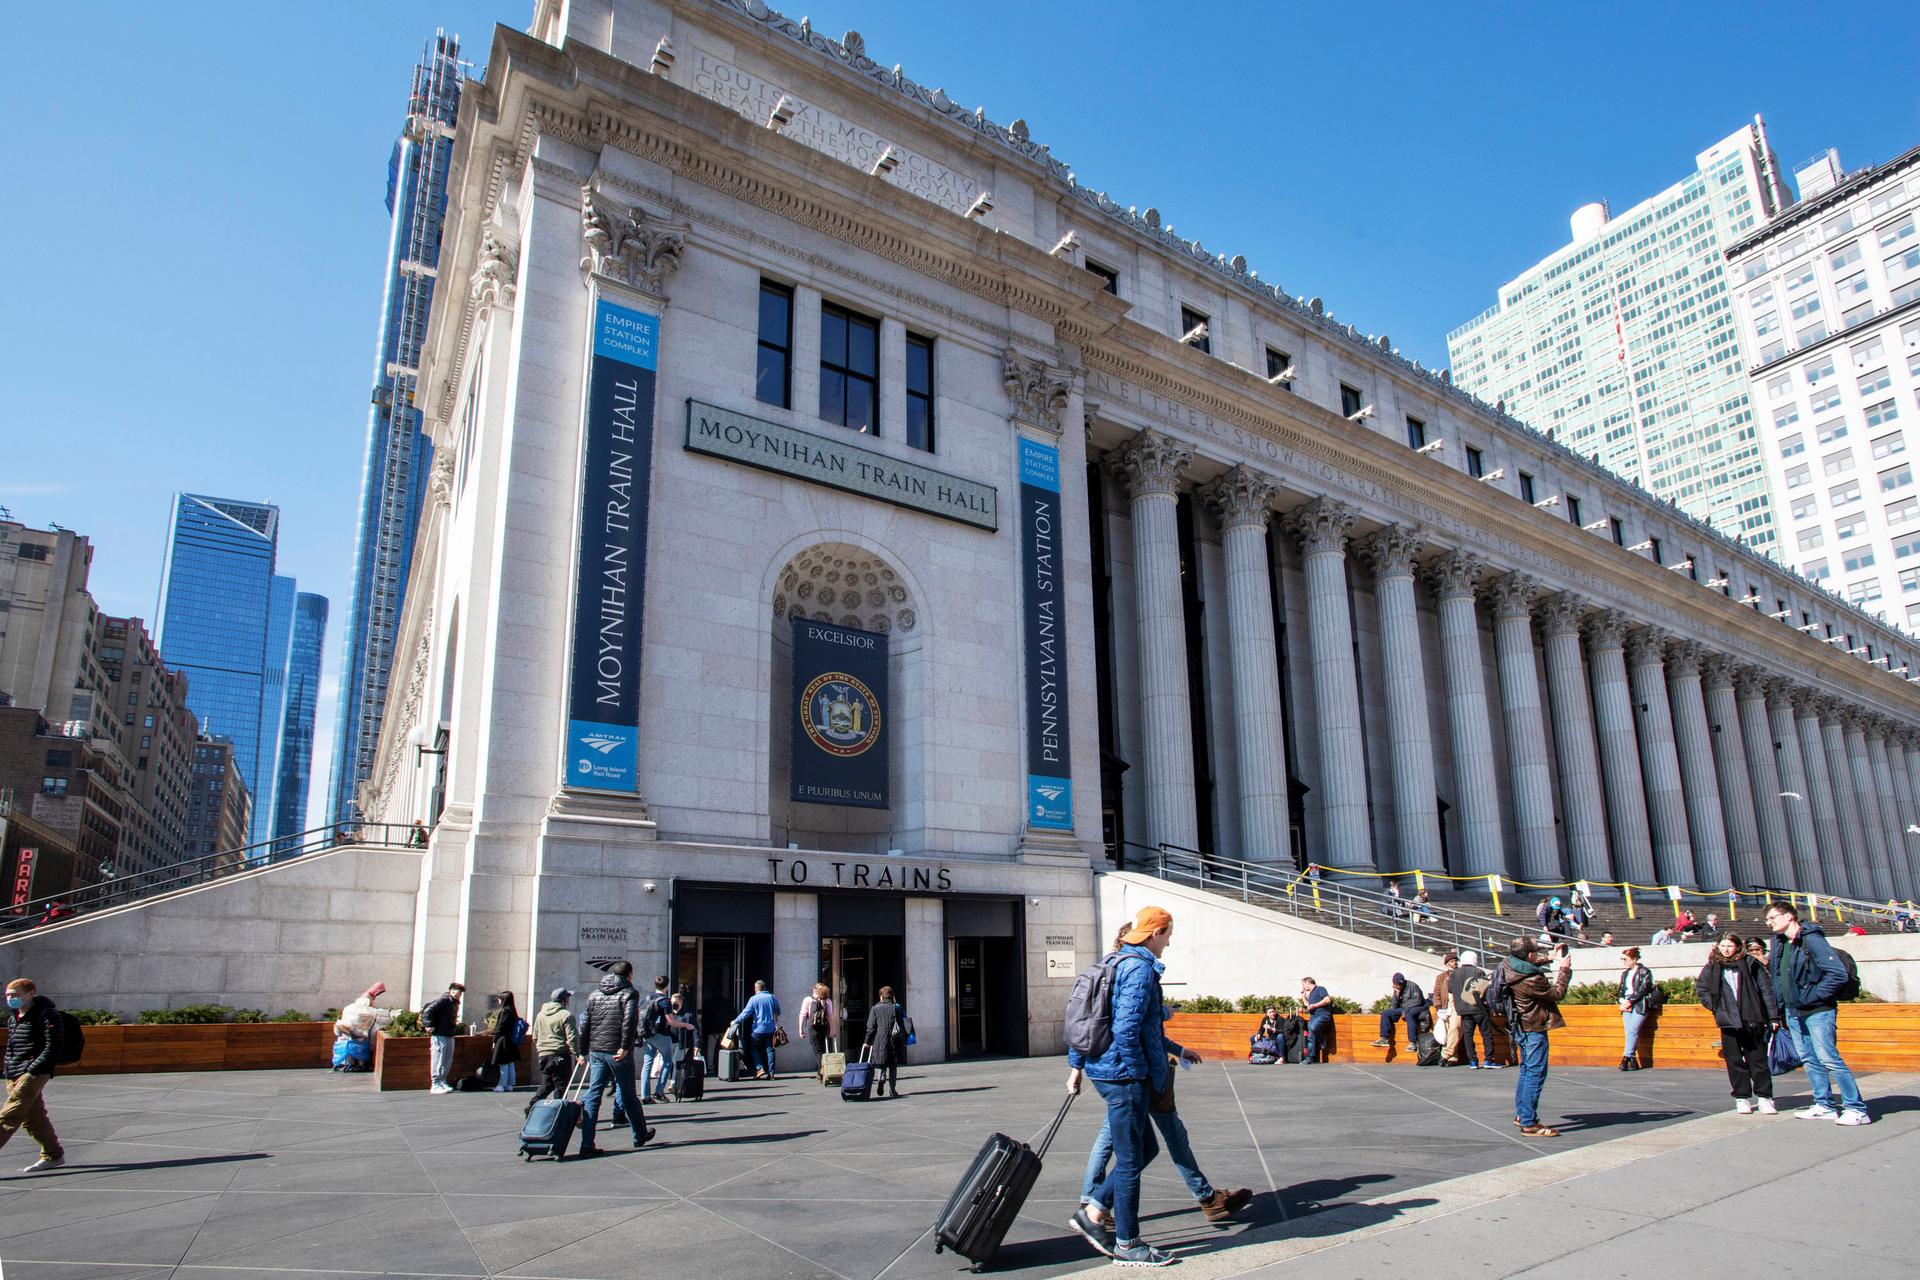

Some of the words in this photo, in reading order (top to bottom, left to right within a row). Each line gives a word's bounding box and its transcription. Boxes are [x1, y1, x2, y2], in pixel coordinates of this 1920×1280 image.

[605, 313, 651, 335] EMPIRE
[604, 326, 650, 346] STATION
[603, 338, 649, 358] COMPLEX
[611, 378, 638, 445] HALL
[1096, 373, 1220, 436] NEITHER
[1233, 427, 1294, 465] SNOW
[1307, 459, 1353, 488] NOR
[1359, 480, 1401, 508] RAIN
[699, 417, 846, 473] MOYNIHAN
[857, 462, 927, 496] TRAIN
[937, 485, 990, 514] HALL
[1024, 447, 1055, 464] EMPIRE
[1024, 458, 1055, 473] STATION
[1024, 468, 1056, 482] COMPLEX
[605, 450, 633, 533] TRAIN
[1034, 500, 1053, 592] STATION
[596, 543, 628, 707] MOYNIHAN
[808, 627, 875, 650] EXCELSIOR
[1037, 599, 1059, 763] PENNSYLVANIA
[588, 732, 627, 741] AMTRAK
[798, 784, 805, 794] E
[807, 785, 851, 798] PLURIBUS
[853, 790, 882, 801] UNUM
[14, 849, 33, 909] PARK
[767, 858, 808, 884] TO
[831, 862, 952, 891] TRAINS
[581, 927, 627, 935] MOYNIHAN
